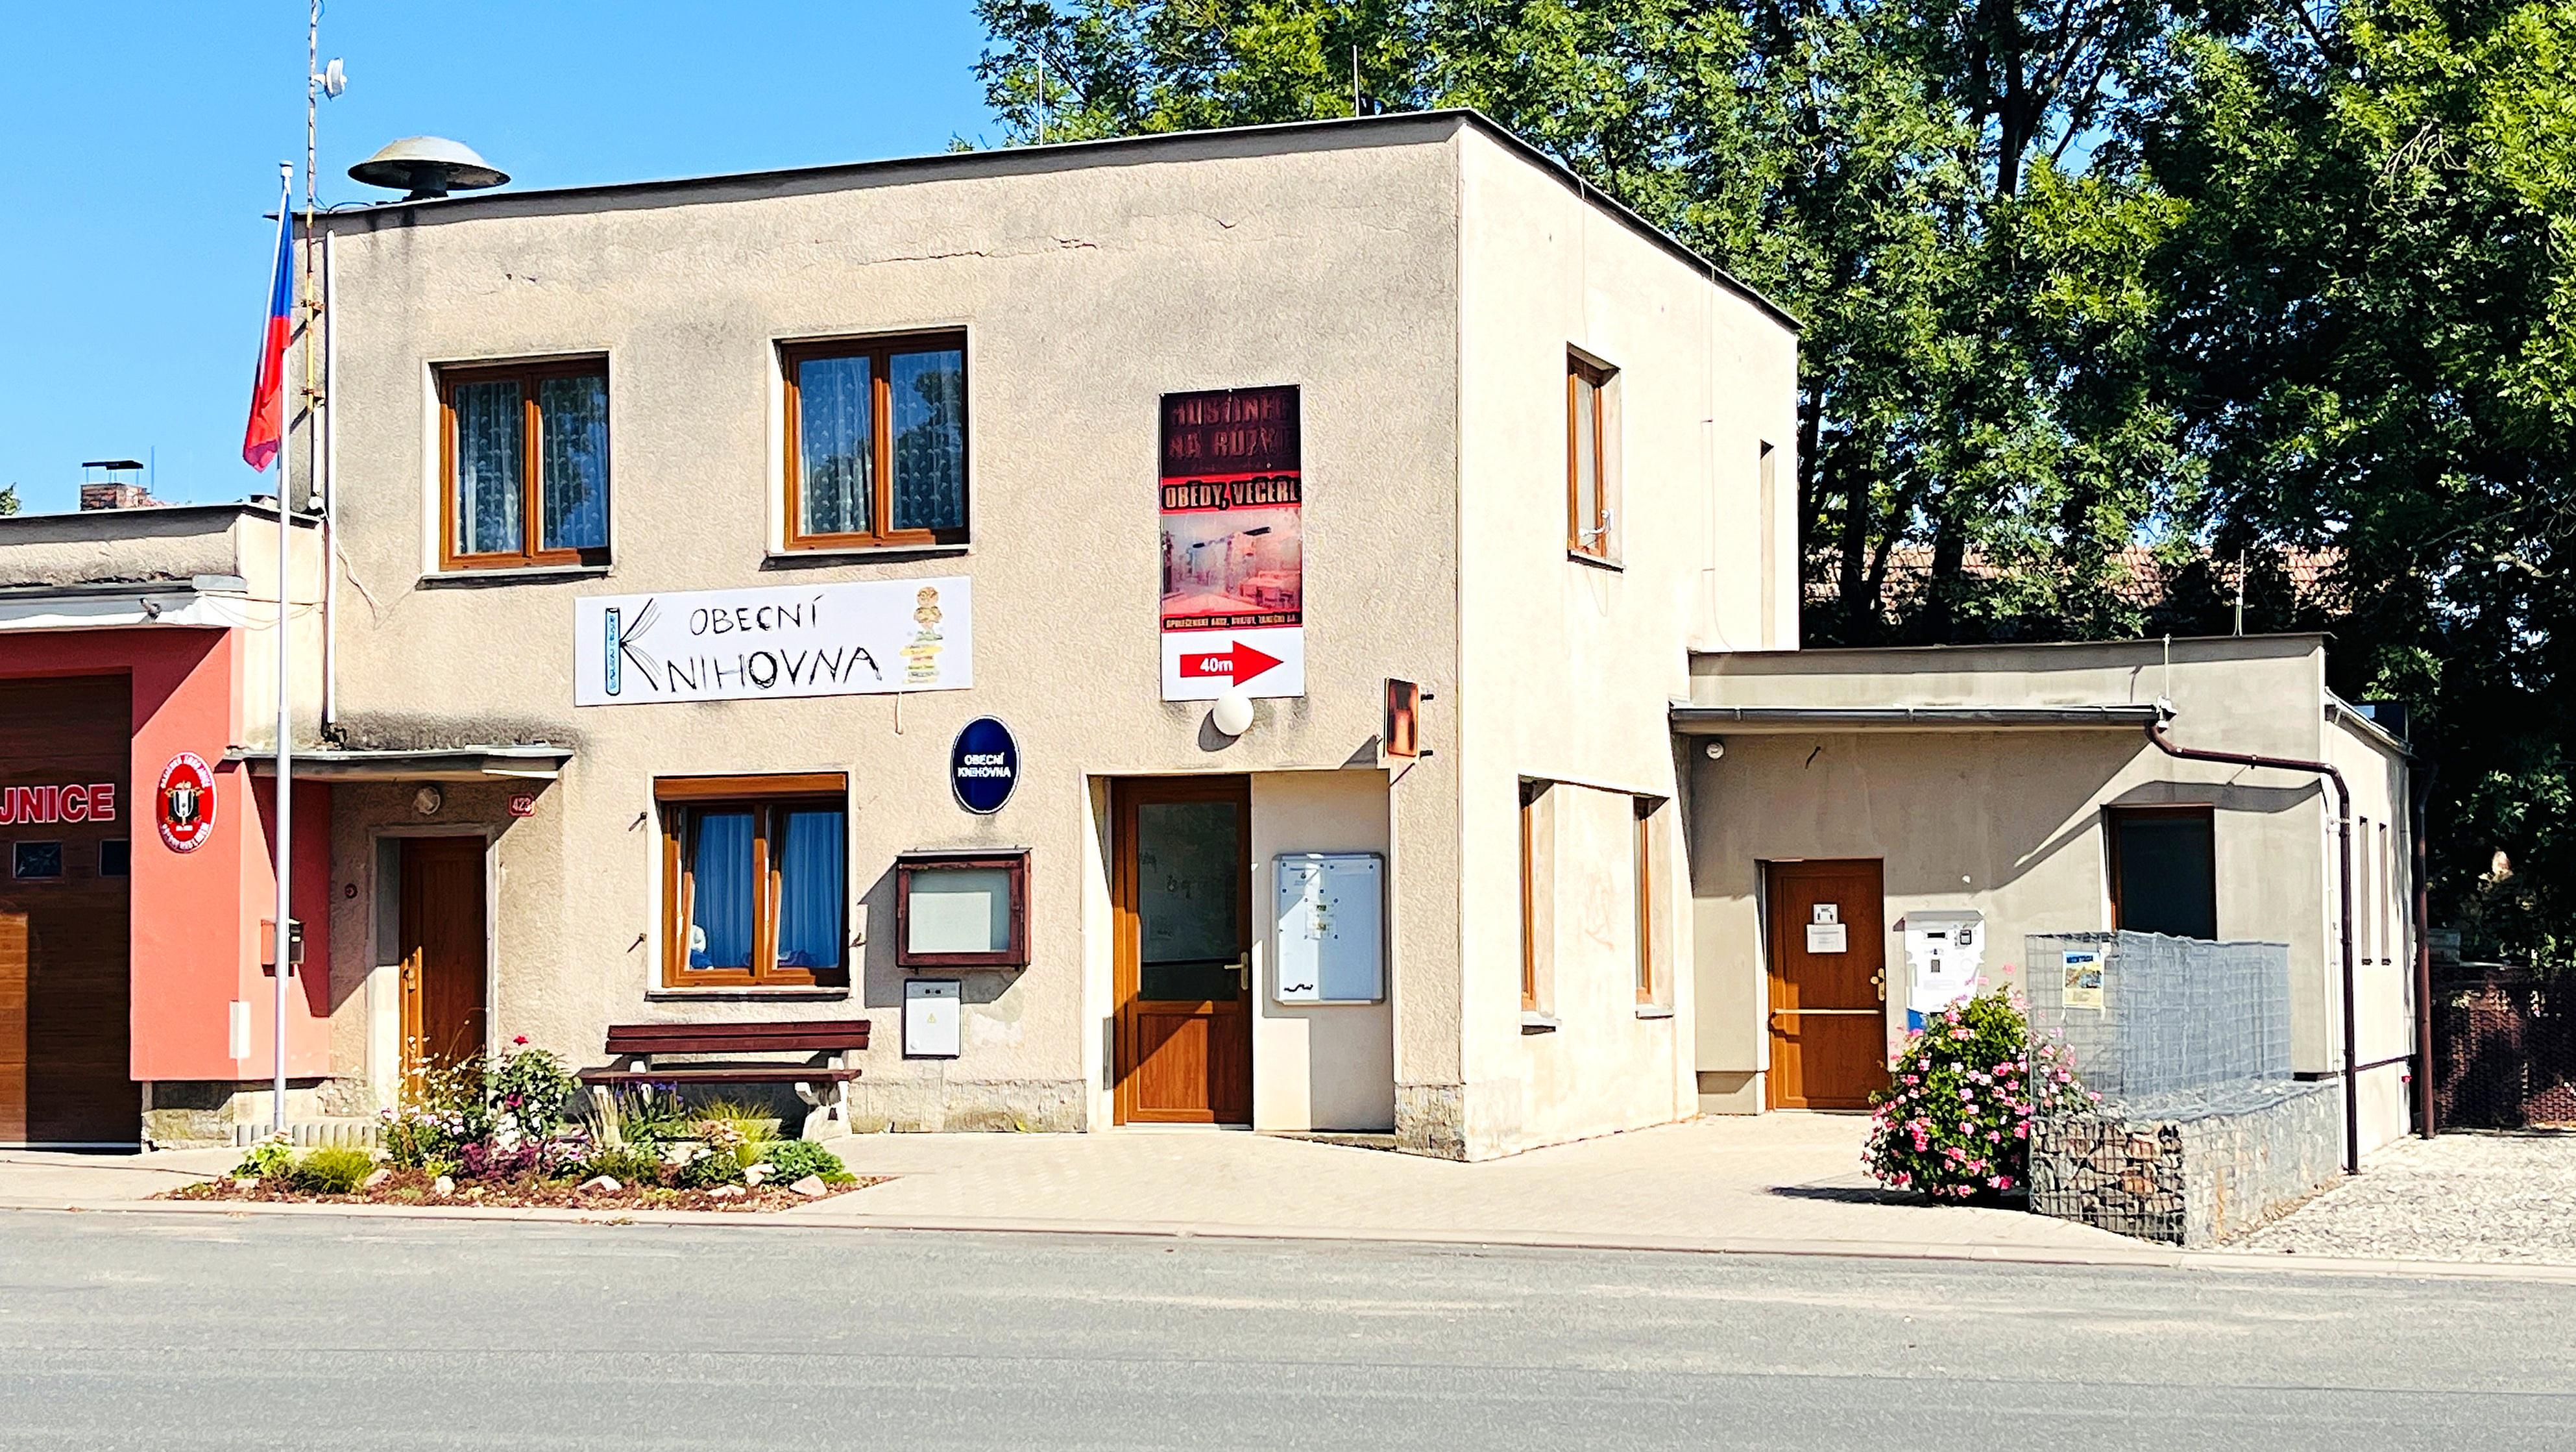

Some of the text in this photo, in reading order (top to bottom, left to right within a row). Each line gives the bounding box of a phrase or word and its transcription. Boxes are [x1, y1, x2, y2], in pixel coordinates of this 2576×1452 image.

[690, 593, 825, 636] OBECNÍ
[605, 597, 883, 697] KNIHOVNA
[1200, 657, 1233, 672] 40m
[964, 752, 1004, 765] OBECNÍ
[958, 766, 1011, 778] KNIHOVNA
